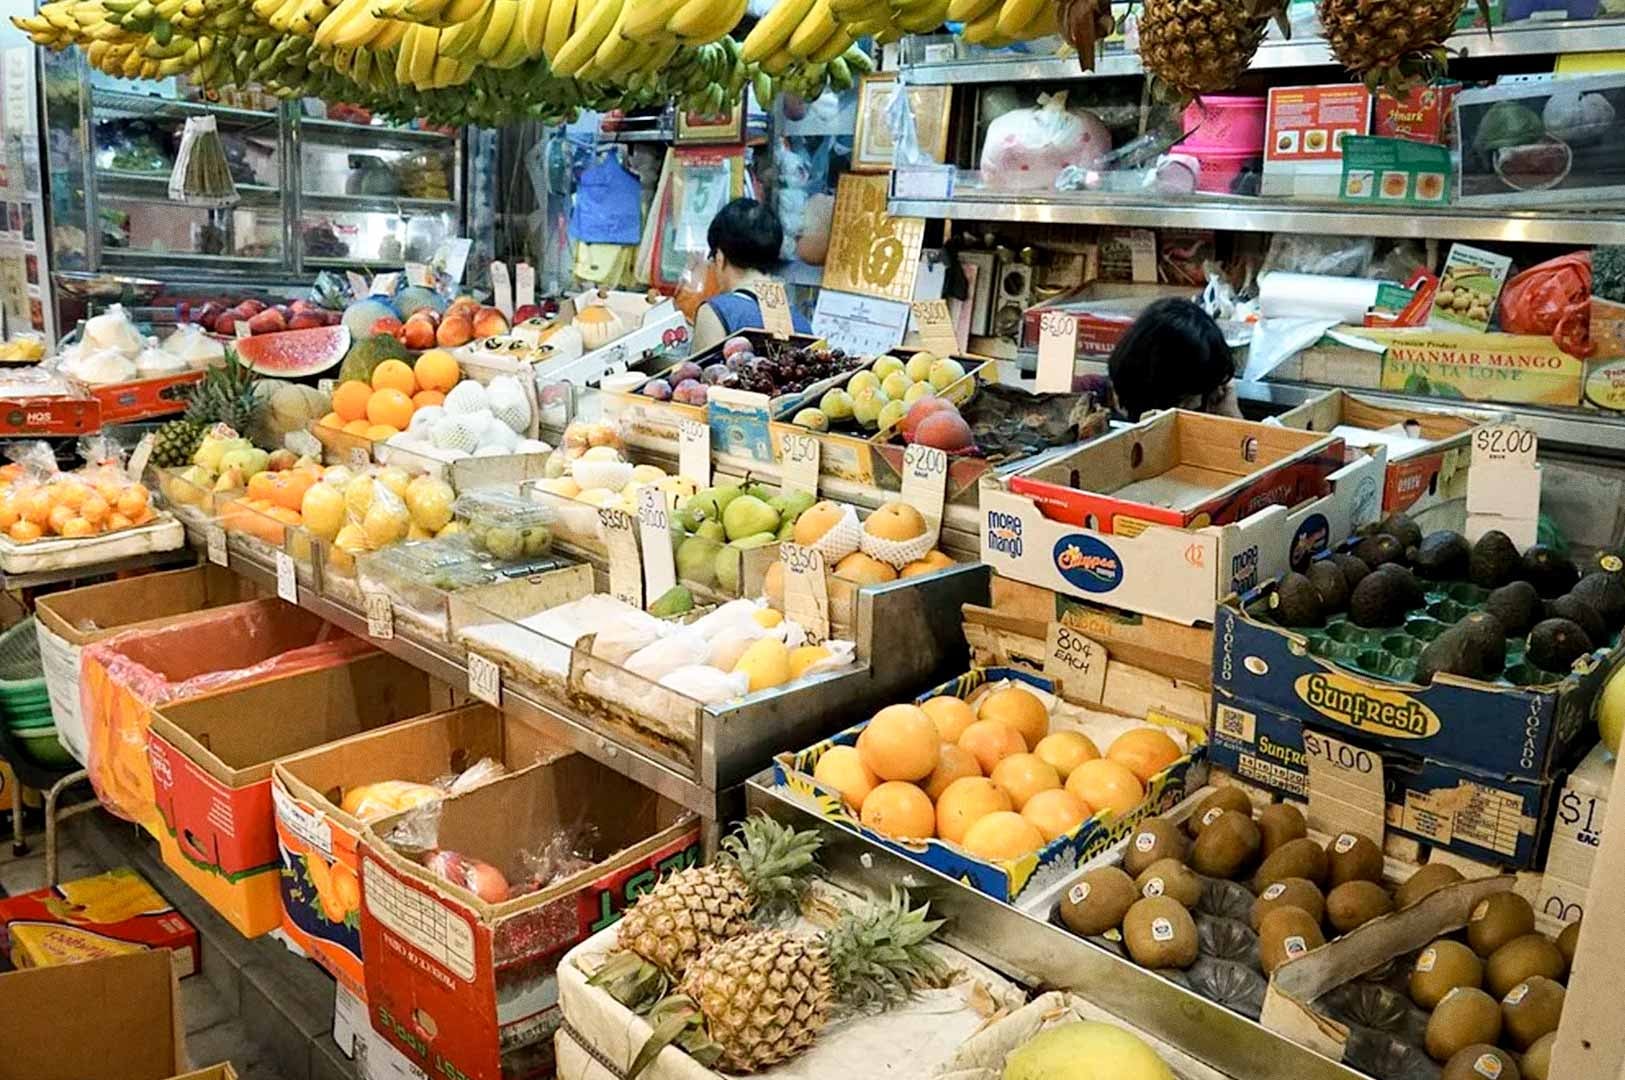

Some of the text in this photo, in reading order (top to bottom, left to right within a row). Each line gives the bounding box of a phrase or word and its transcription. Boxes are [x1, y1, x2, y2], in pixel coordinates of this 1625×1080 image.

[1391, 348, 1563, 370] MYANMAR MANGO
[1477, 429, 1533, 453] $2.00
[1053, 649, 1090, 675] EACH
[1221, 615, 1235, 681] AVOCADO
[1520, 694, 1542, 769] AVOCADO
[1258, 735, 1308, 765] Sunfre
[1304, 733, 1373, 774] $1.00
[1576, 832, 1600, 847] EAC
